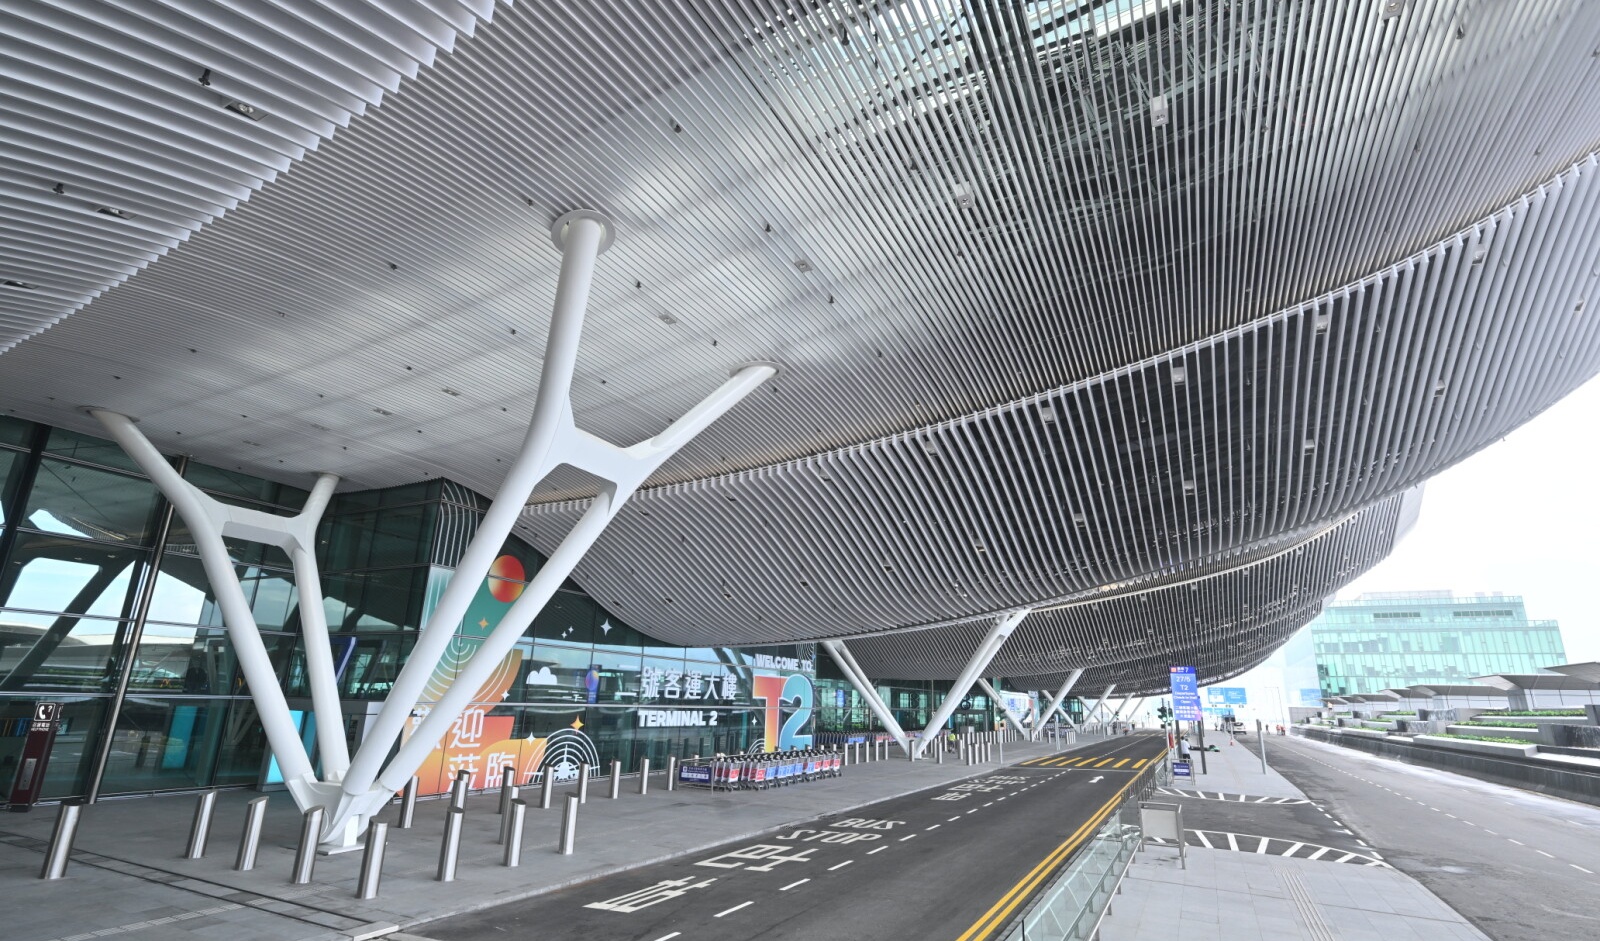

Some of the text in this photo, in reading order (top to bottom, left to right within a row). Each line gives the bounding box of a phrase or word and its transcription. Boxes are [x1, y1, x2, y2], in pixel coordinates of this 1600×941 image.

[754, 653, 812, 672] WELCOME TO
[615, 664, 738, 700] 二號客運大樓
[637, 710, 718, 727] TERMINAL 2
[753, 673, 814, 754] T2
[828, 818, 906, 830] BUS
[775, 829, 883, 844] STOP
[693, 844, 820, 872] 巴士
[582, 876, 718, 913] 站
